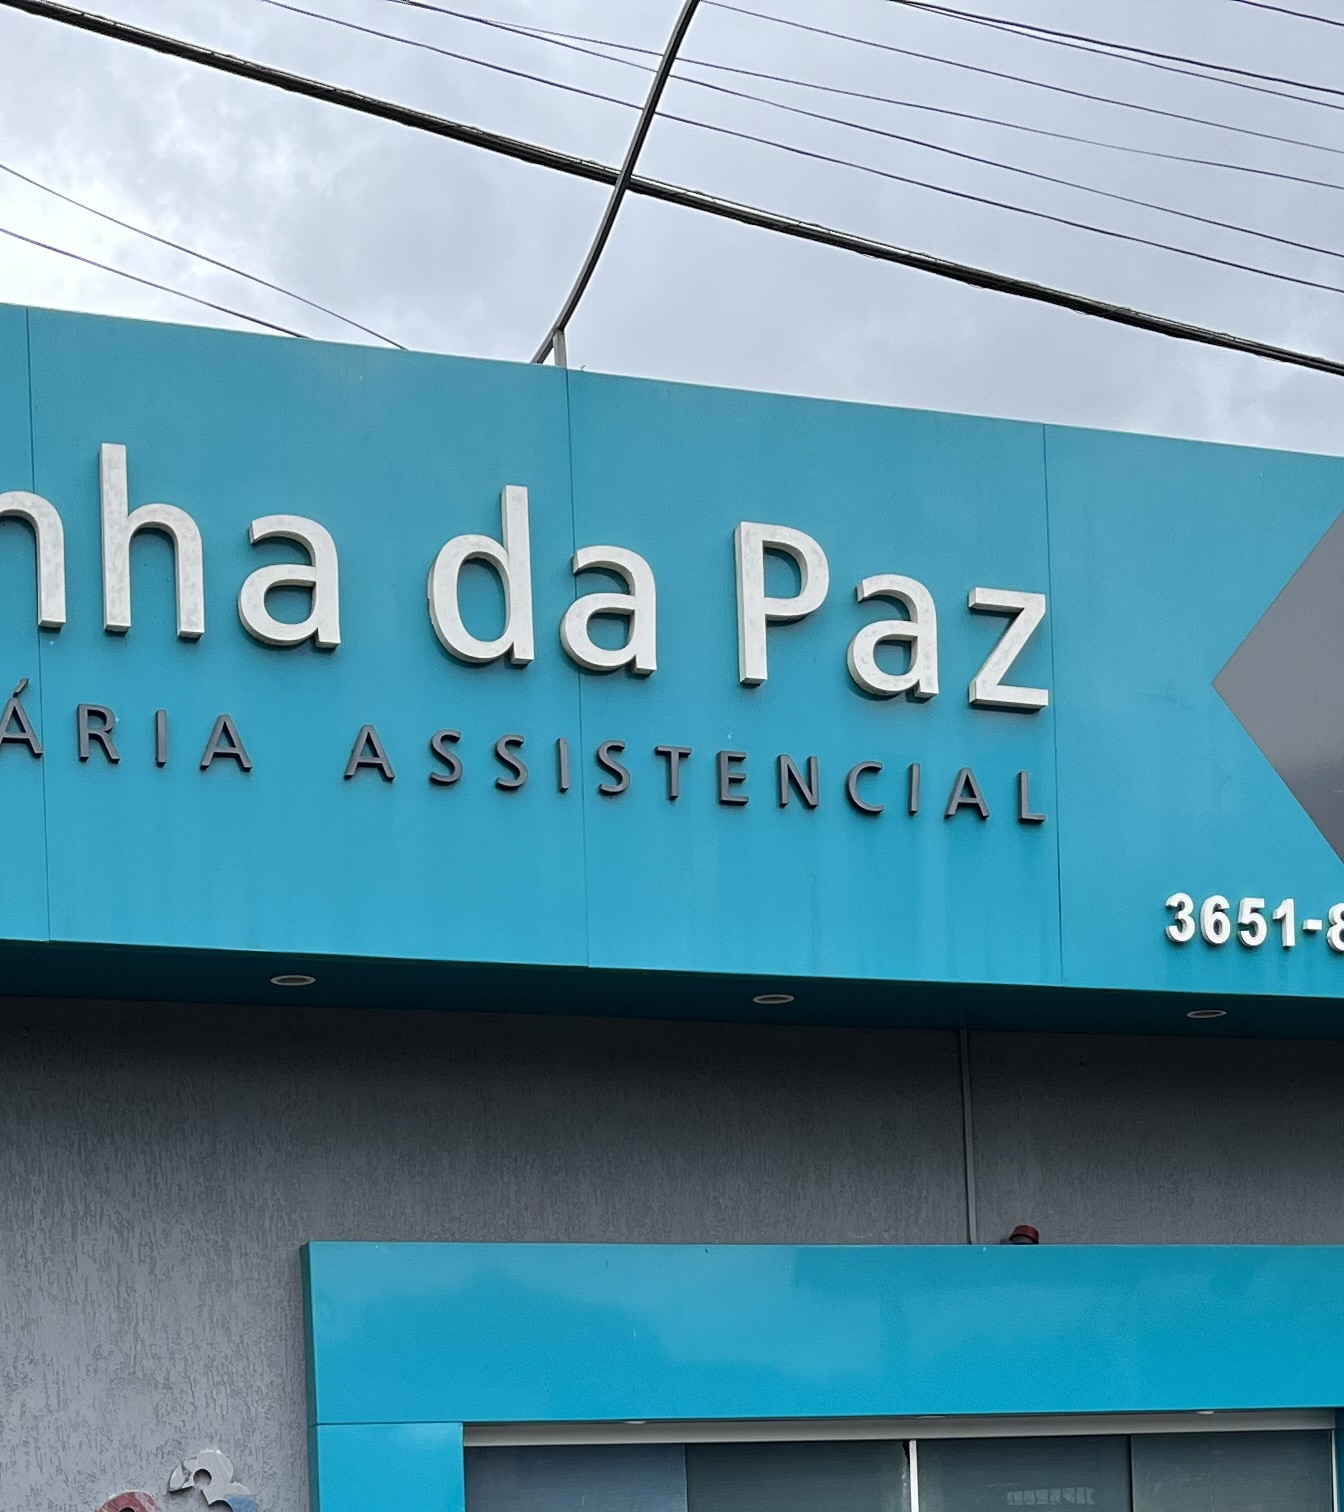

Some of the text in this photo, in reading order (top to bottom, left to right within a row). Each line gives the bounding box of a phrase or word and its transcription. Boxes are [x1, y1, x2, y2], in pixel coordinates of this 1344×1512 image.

[428, 484, 657, 676] da
[734, 520, 1050, 710] Paz
[343, 724, 1047, 825] ASSISTENCIAL
